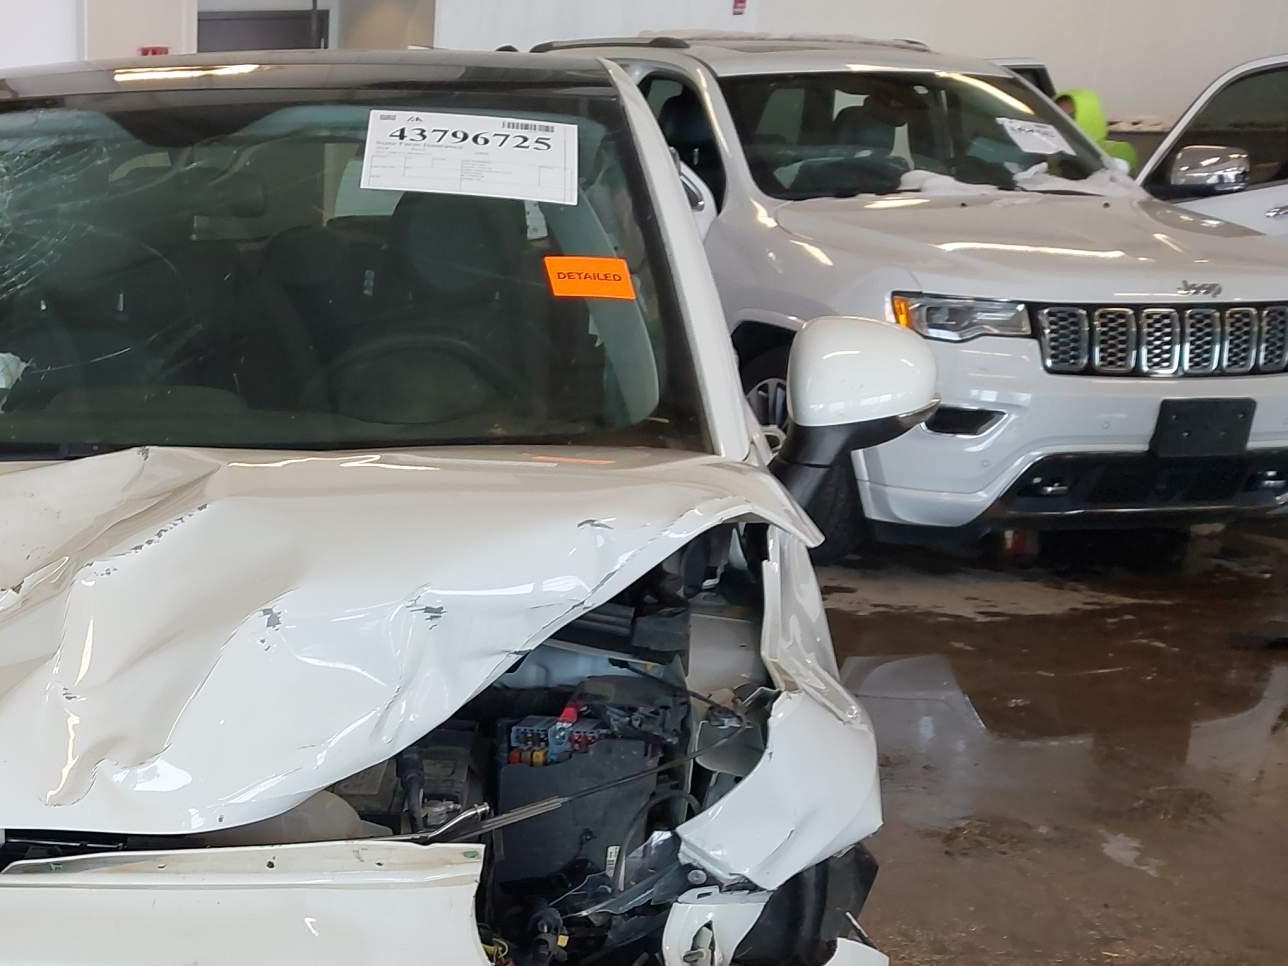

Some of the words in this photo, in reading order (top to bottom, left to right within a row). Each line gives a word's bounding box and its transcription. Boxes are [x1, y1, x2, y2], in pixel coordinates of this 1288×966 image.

[388, 127, 552, 151] 43796725
[557, 271, 622, 282] DETAILED
[1176, 280, 1222, 298] Jeep
